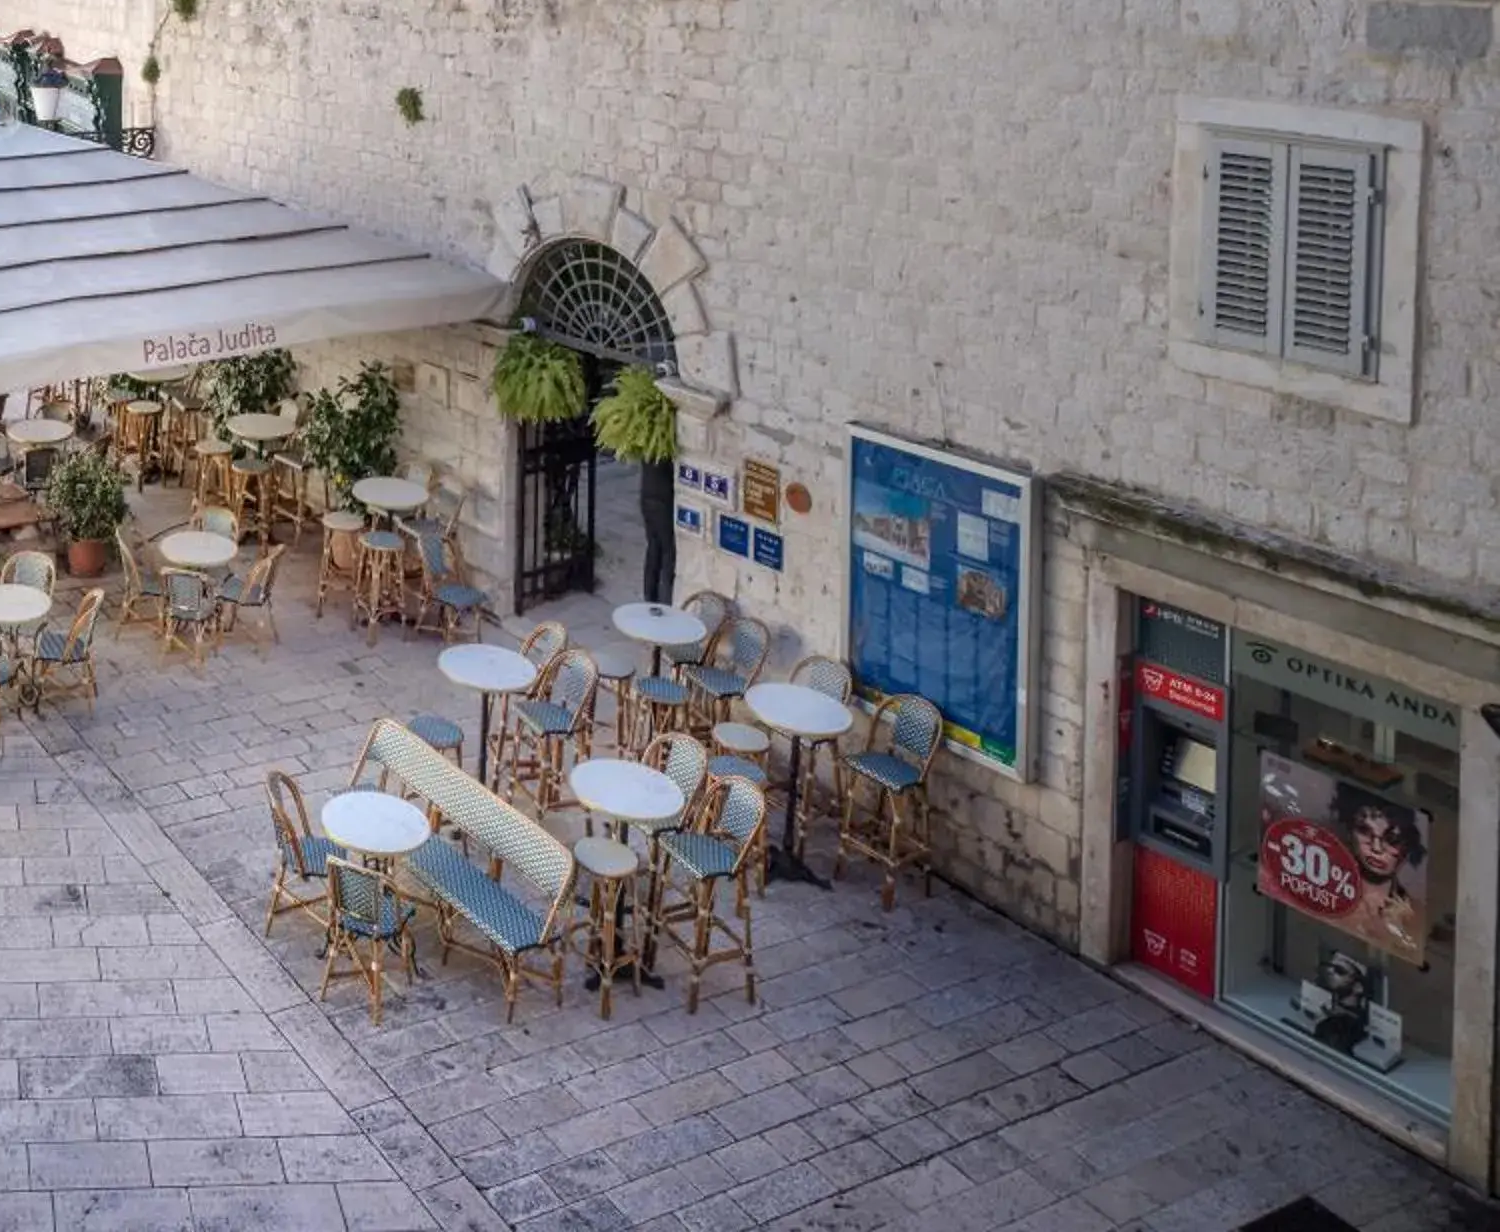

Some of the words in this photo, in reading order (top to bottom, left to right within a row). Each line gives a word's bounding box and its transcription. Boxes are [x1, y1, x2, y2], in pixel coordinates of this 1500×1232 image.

[143, 332, 210, 363] Palača
[216, 323, 276, 353] Judita
[1169, 679, 1193, 693] ATM
[1286, 656, 1375, 700] OPTIKA
[1385, 691, 1457, 727] ANDA
[1267, 834, 1355, 900] -30%
[1281, 872, 1339, 909] POPUST
